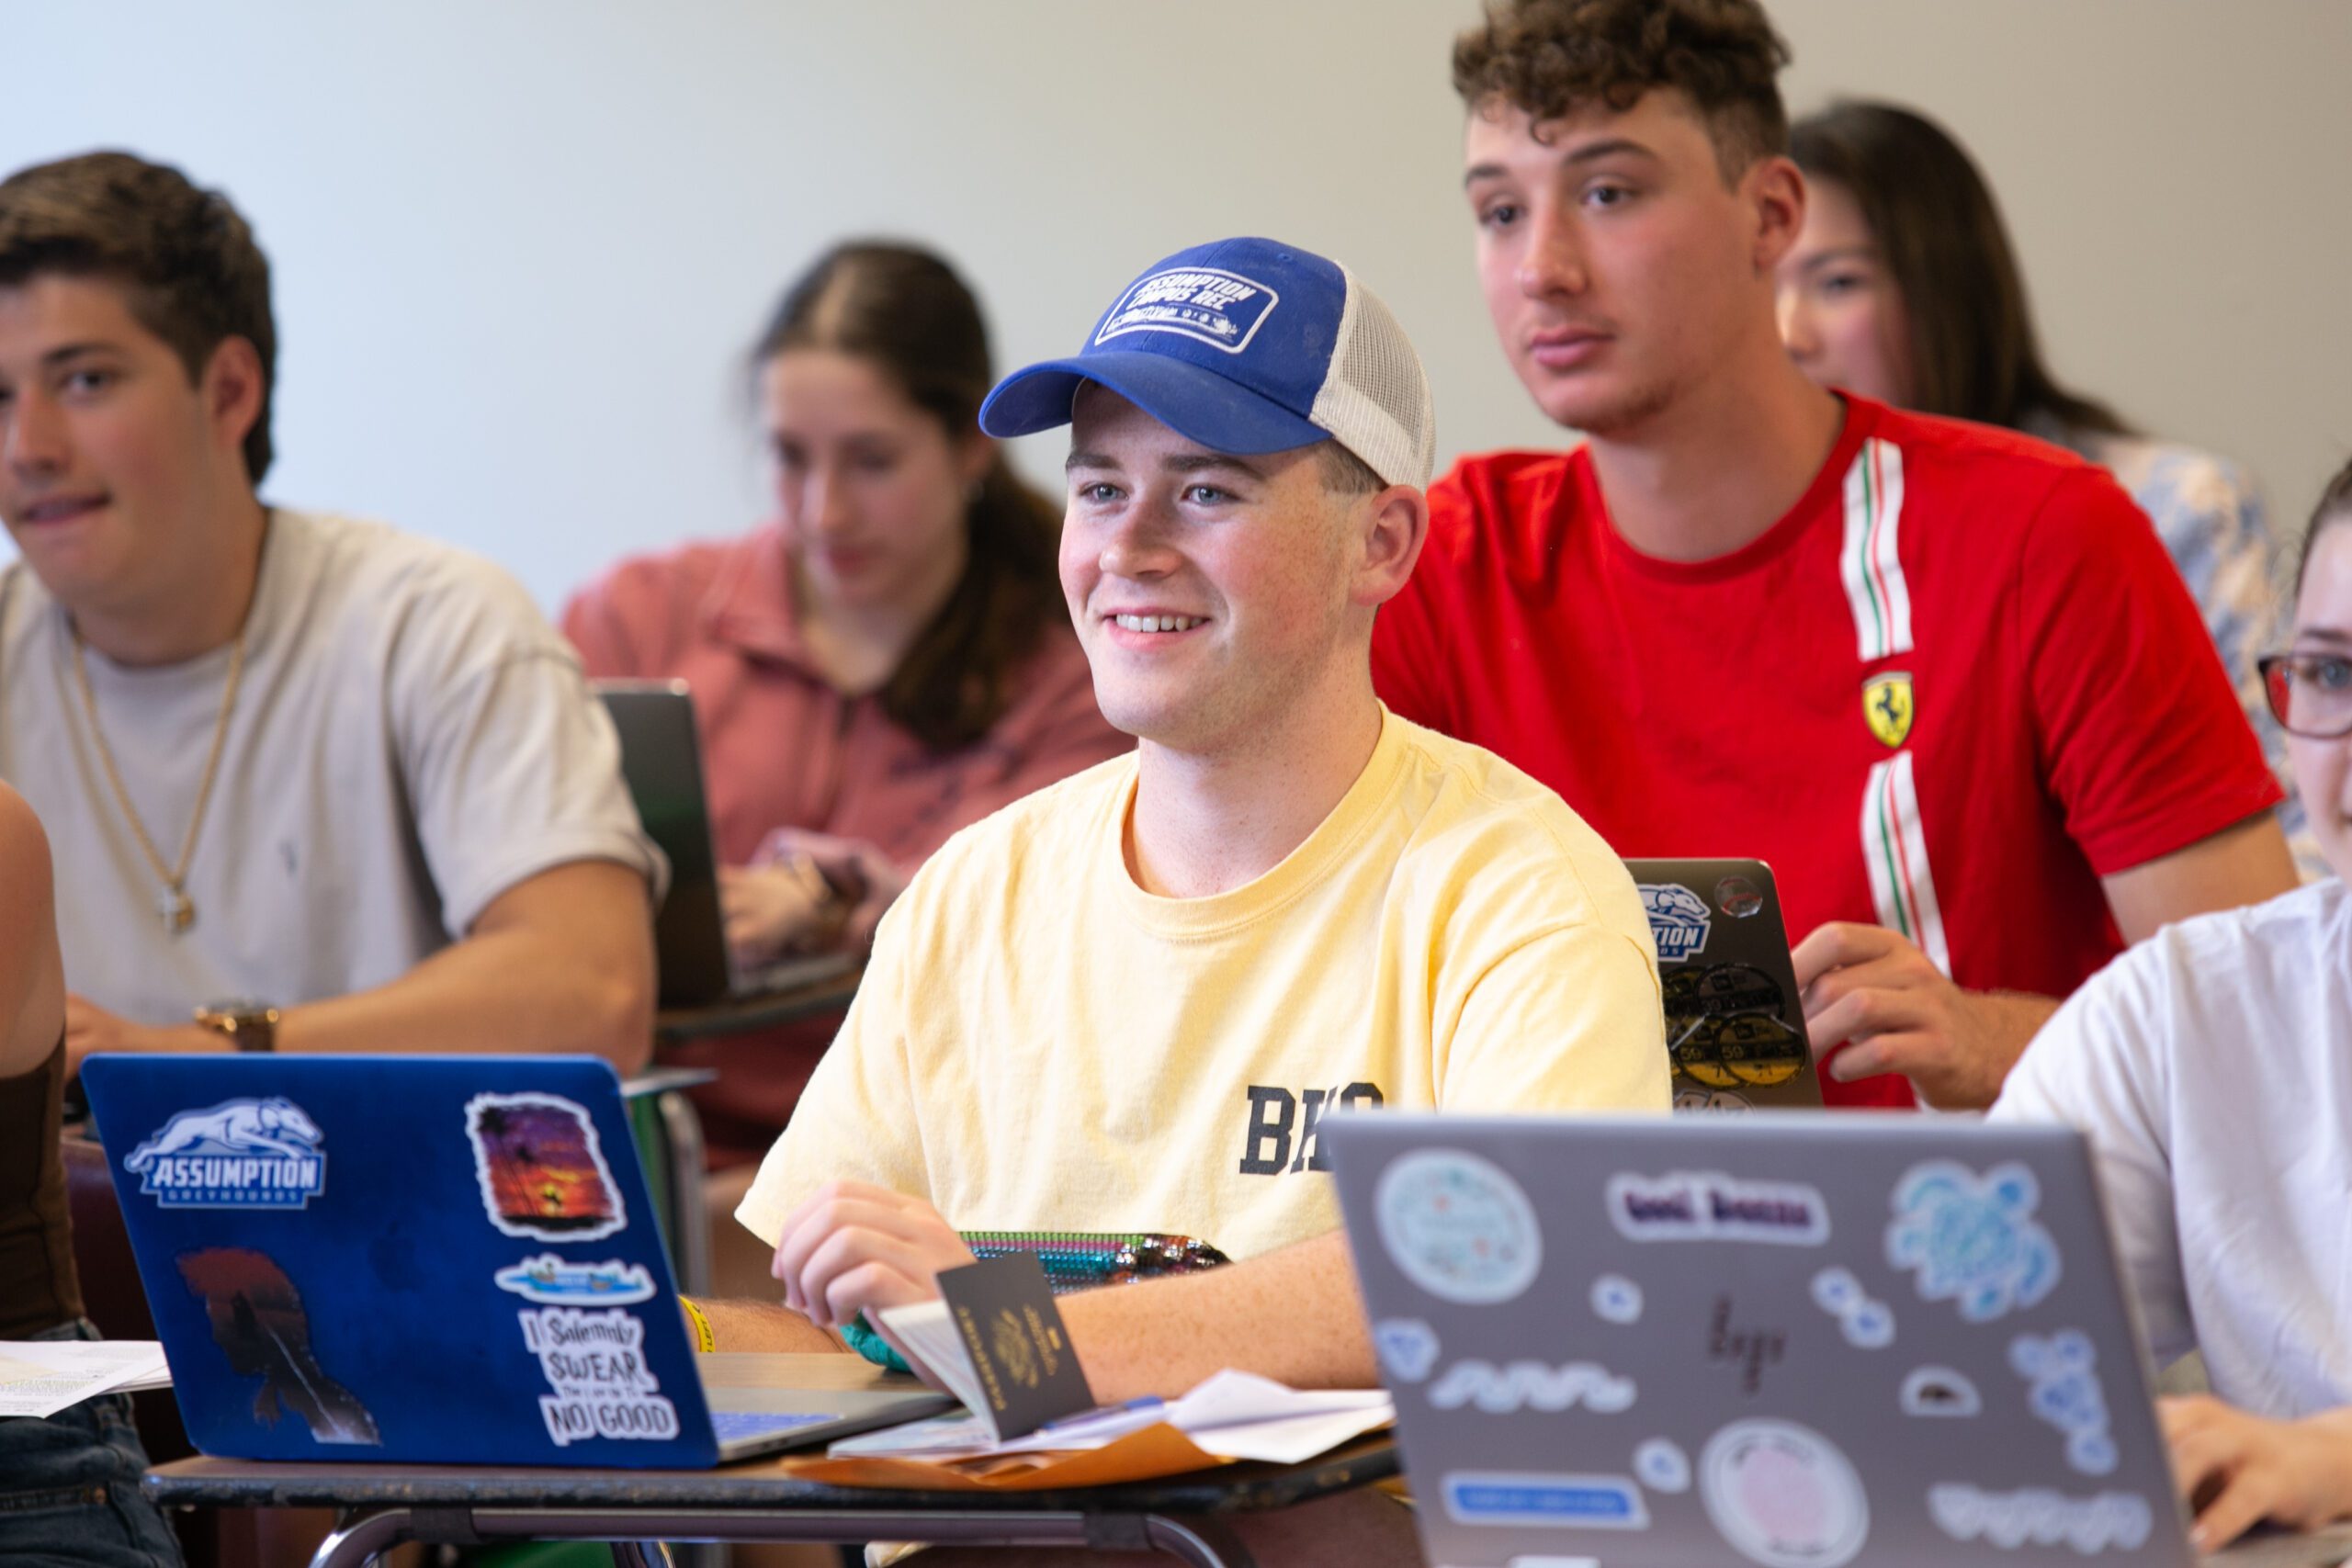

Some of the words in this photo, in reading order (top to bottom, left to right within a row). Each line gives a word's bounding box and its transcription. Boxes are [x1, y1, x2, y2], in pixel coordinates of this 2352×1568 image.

[1133, 273, 1257, 301] ASSUMPTION
[1191, 289, 1236, 311] REC
[152, 1157, 318, 1189] ASSUMPTION
[168, 1189, 298, 1202] GREYHOUNDS
[526, 1319, 539, 1347] I
[548, 1351, 646, 1383] SWEAR
[548, 1404, 588, 1435] NO
[598, 1404, 671, 1434] GOOD
